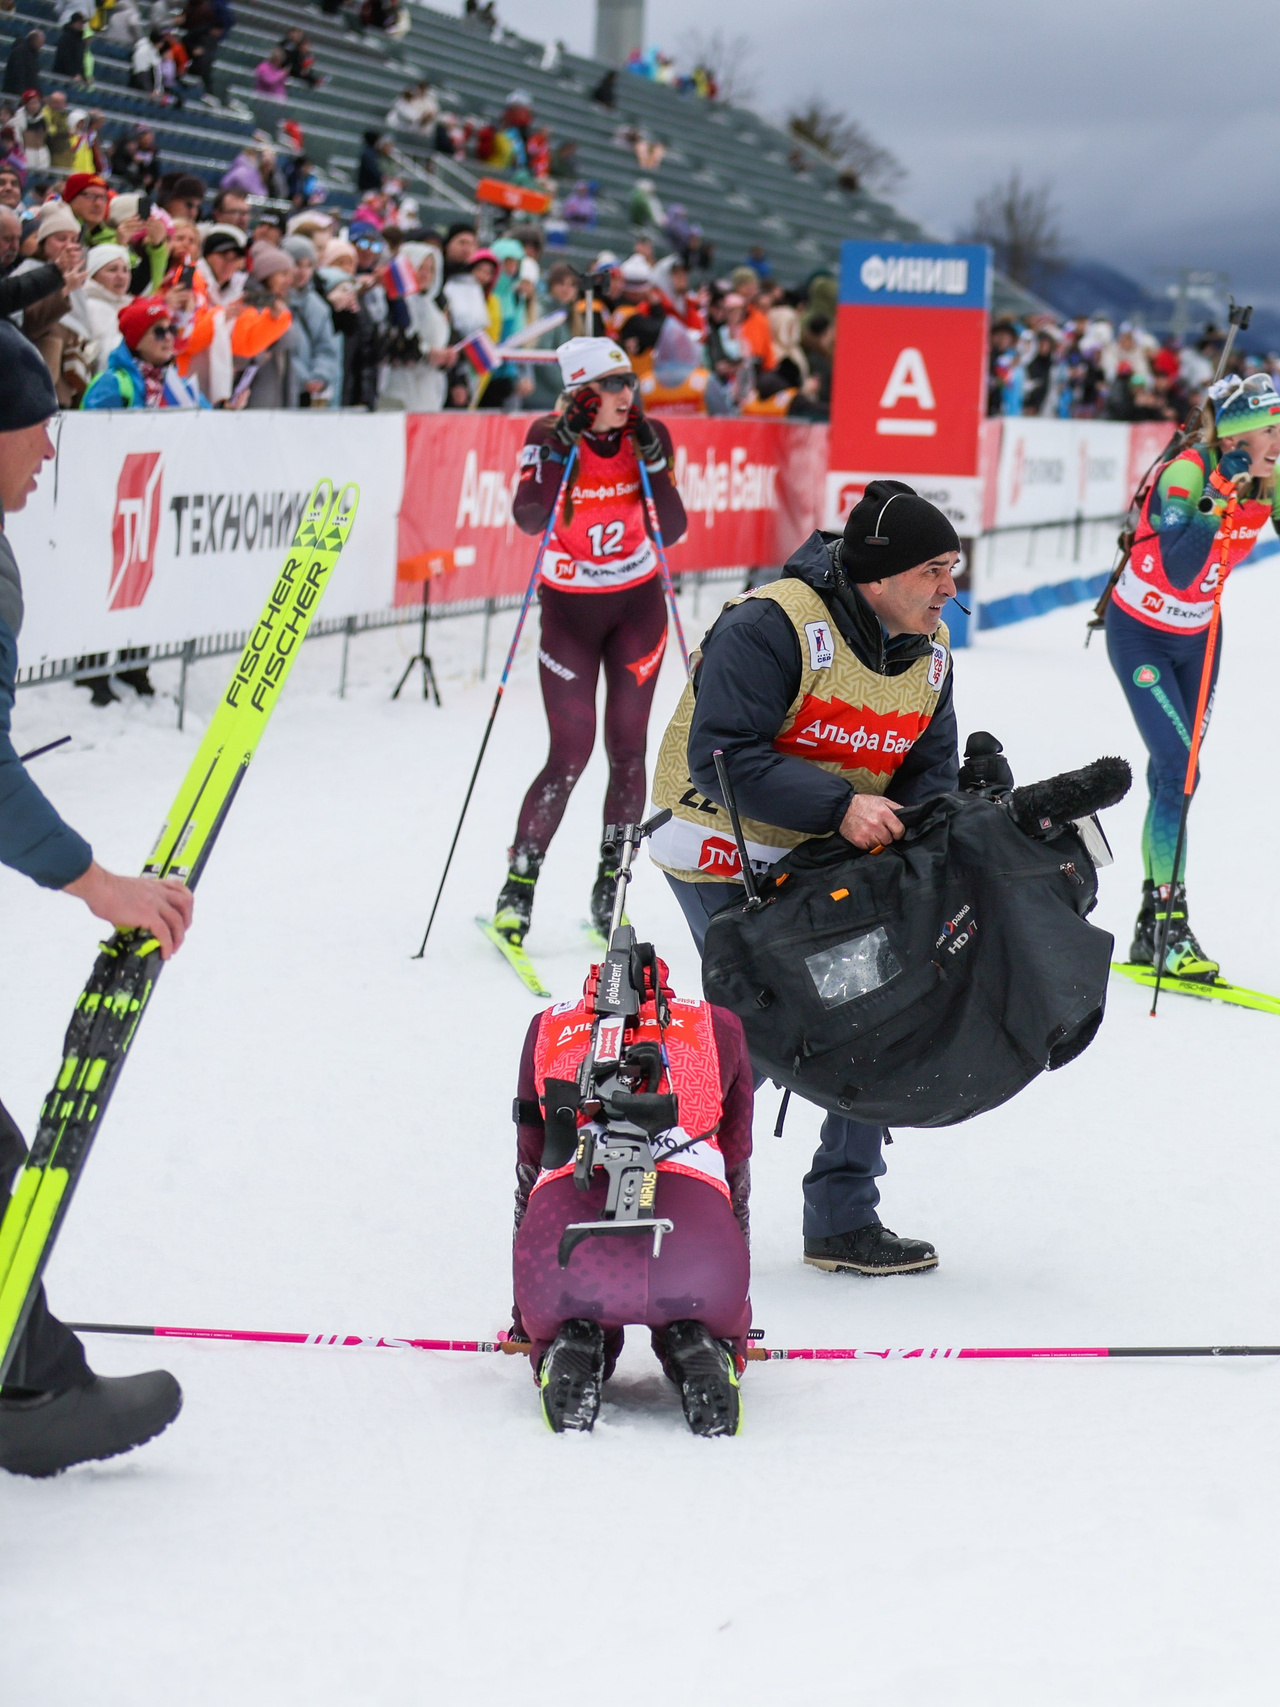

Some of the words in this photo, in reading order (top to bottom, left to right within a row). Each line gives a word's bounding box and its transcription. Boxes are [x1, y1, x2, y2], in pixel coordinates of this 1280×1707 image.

[860, 254, 969, 295] ФИНИШ
[878, 347, 937, 411] А
[571, 484, 615, 504] Альфа
[587, 519, 626, 557] 12
[1141, 554, 1155, 573] 5
[1199, 562, 1221, 594] 5
[225, 558, 303, 709] FISCHER
[250, 561, 329, 713] FISCHER
[796, 719, 880, 753] Альфа
[881, 730, 917, 754] Бан
[607, 962, 623, 1006] globalrent
[1178, 981, 1213, 993] FISCHER
[556, 1021, 593, 1047] Аль
[638, 1016, 685, 1029] Бак
